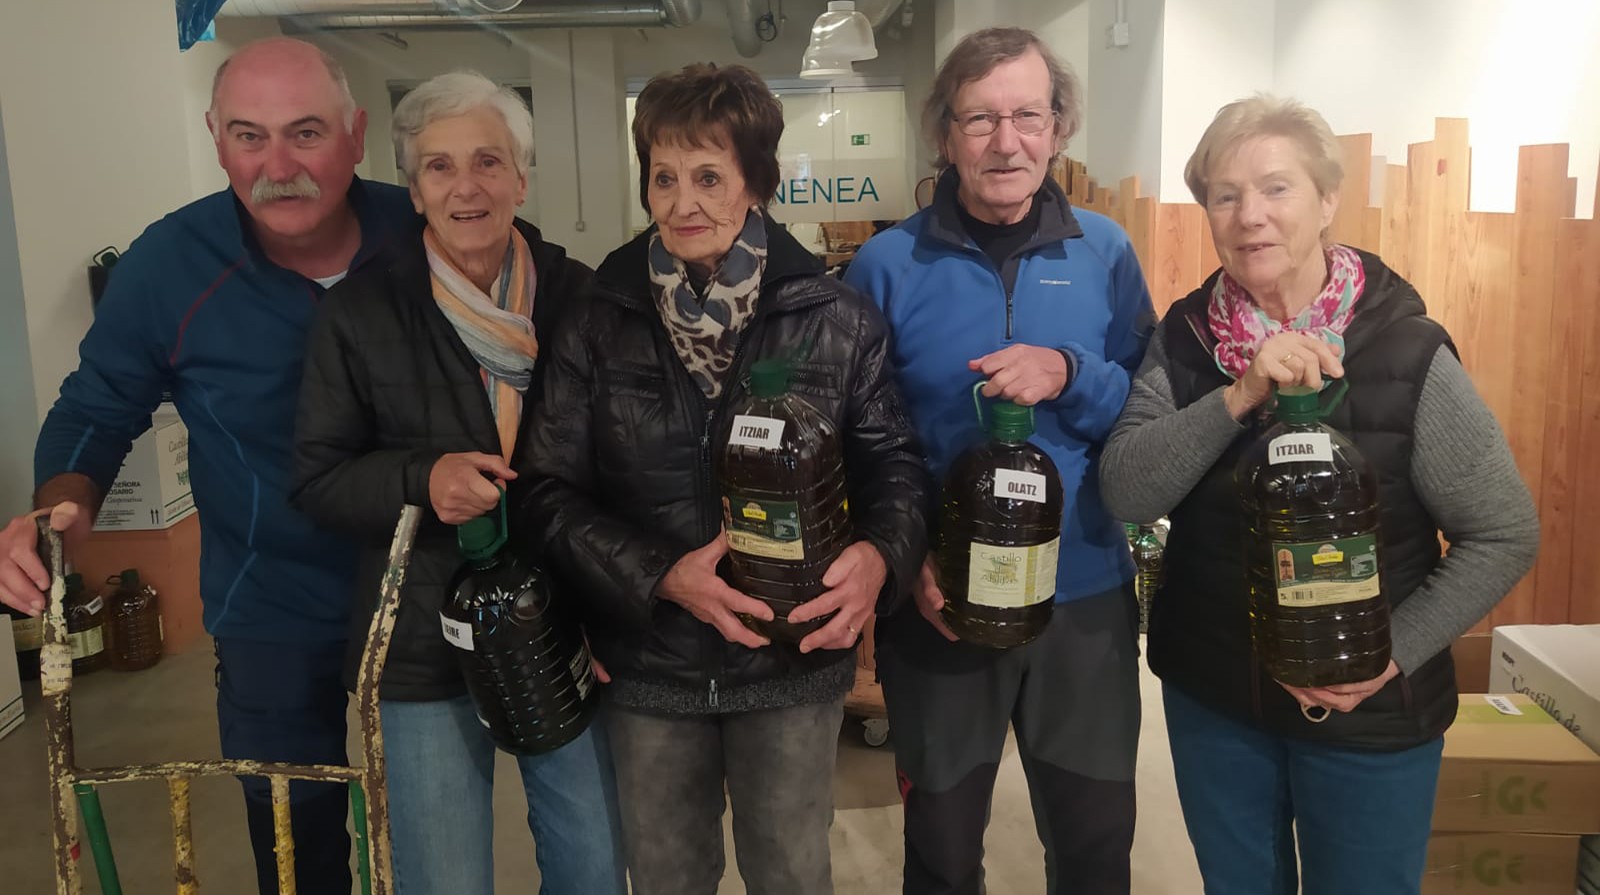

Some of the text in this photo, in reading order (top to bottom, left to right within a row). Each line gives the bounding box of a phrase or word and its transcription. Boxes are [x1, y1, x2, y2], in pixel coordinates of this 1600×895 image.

[739, 425, 770, 440] ITZIAR
[1276, 443, 1314, 457] ITZIAR
[108, 488, 134, 496] OSARIO
[1008, 481, 1037, 496] OLATZ
